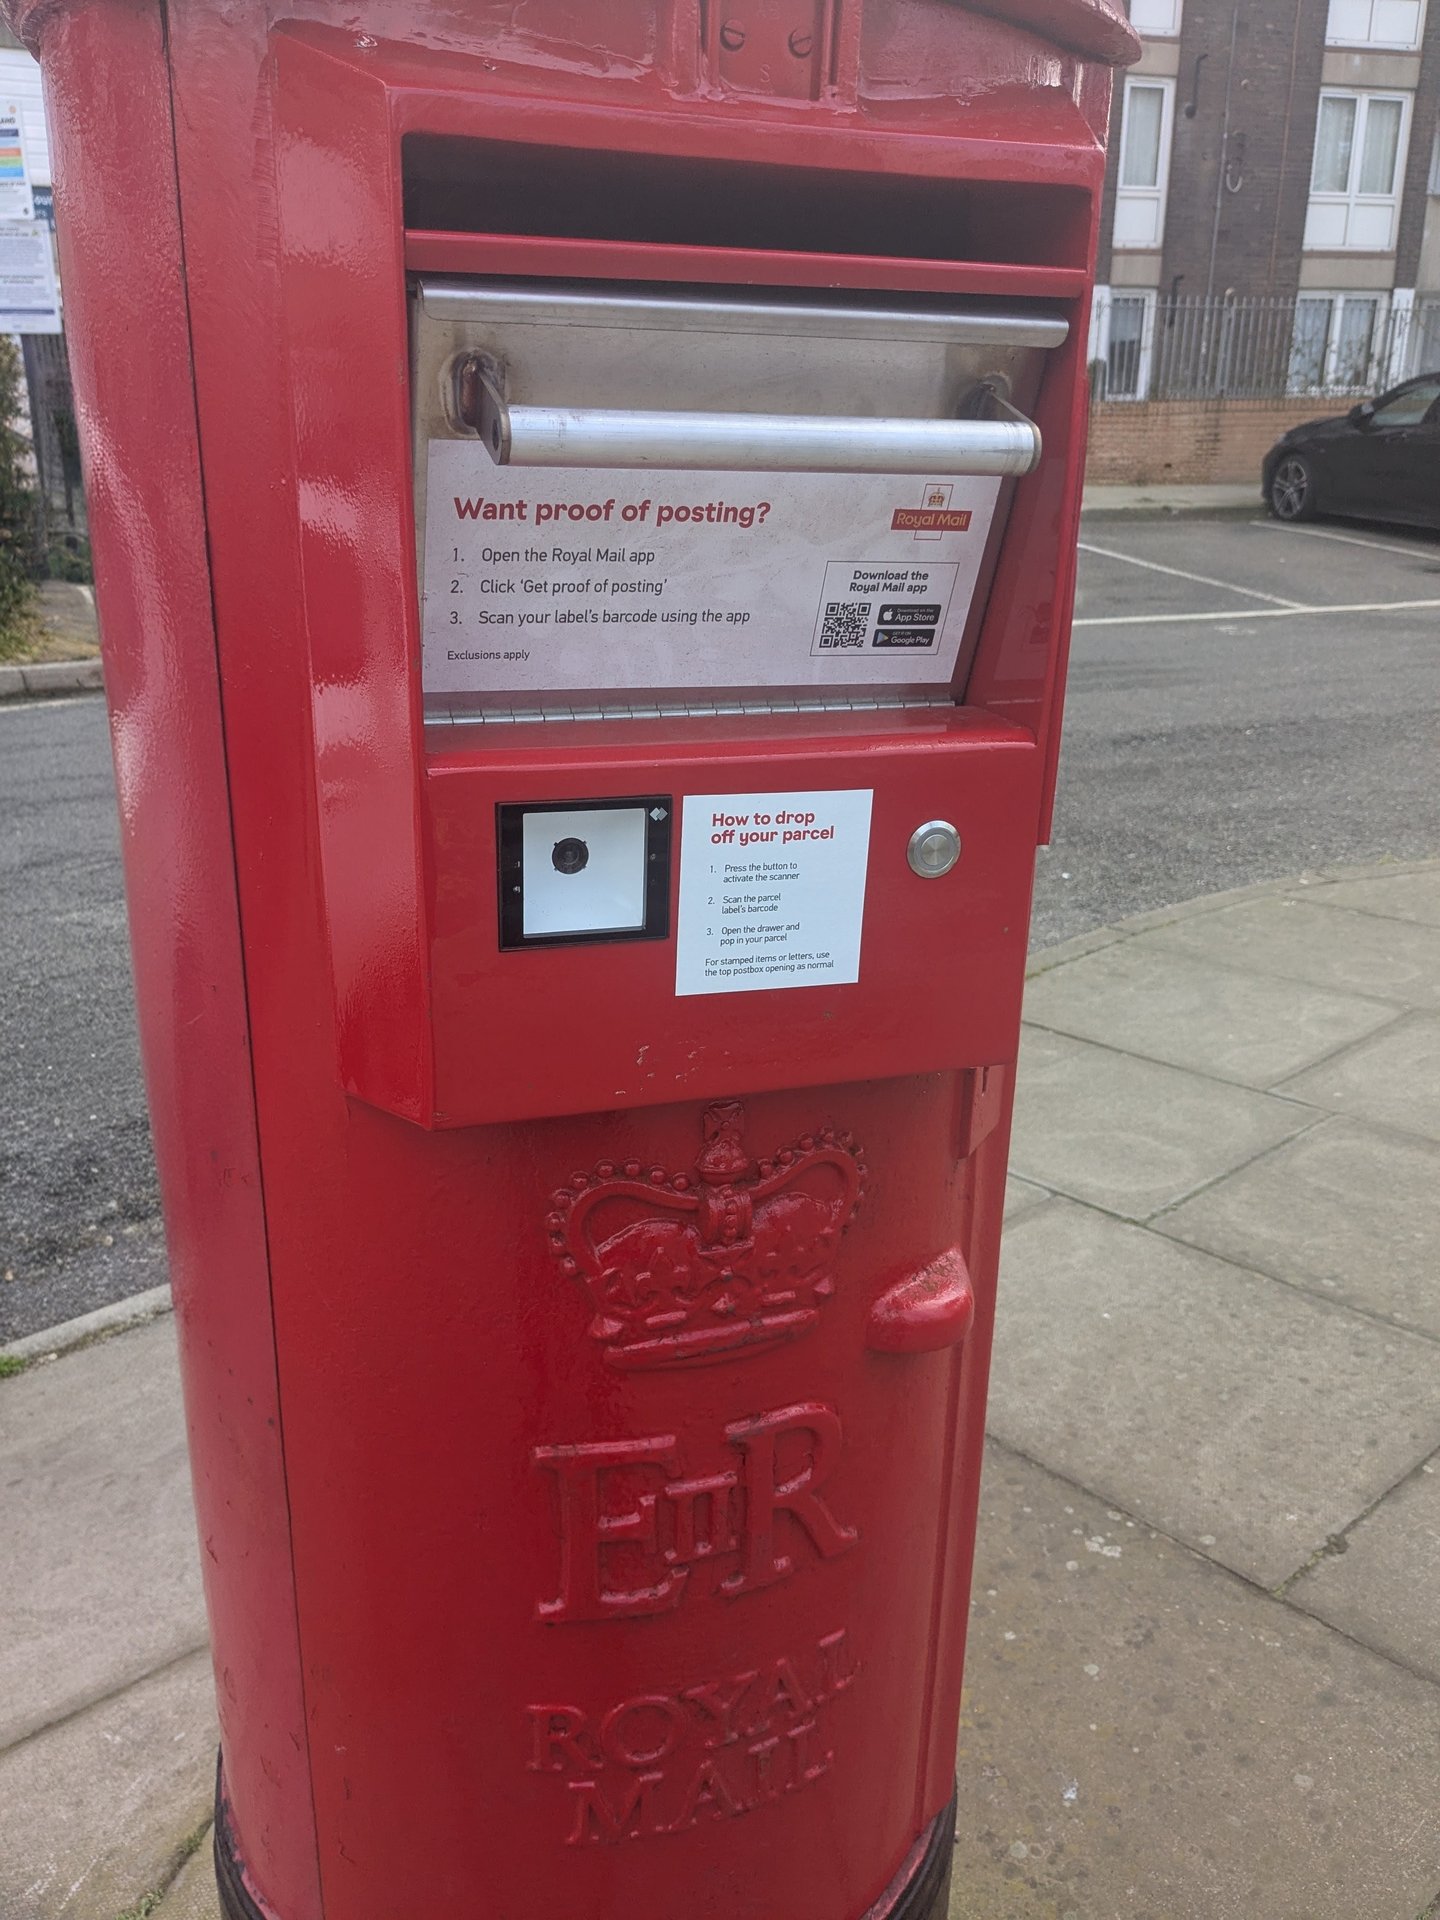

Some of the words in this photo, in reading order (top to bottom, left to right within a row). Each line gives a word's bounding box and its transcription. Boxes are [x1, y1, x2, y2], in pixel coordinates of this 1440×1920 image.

[453, 497, 528, 521] Want
[535, 499, 616, 526] proof
[621, 499, 652, 522] of
[656, 501, 771, 528] posting?
[896, 512, 935, 528] Royal
[936, 513, 968, 527] Mail
[452, 547, 465, 563] 1.
[481, 547, 520, 566] Open
[524, 547, 548, 563] the
[552, 547, 592, 566] Royal
[596, 547, 626, 563] Mail
[629, 550, 656, 566] app
[852, 570, 909, 581] Download
[911, 570, 929, 581] the
[450, 579, 464, 594] 2.
[480, 578, 516, 594] Click
[552, 578, 591, 597] proof
[594, 578, 609, 594] of
[849, 582, 880, 595] Royal
[881, 582, 905, 593] Mail
[907, 584, 928, 595] app
[449, 610, 463, 625] 3.
[478, 610, 514, 625] Scan
[518, 612, 551, 628] your
[602, 609, 658, 623] barcode
[661, 609, 698, 626] using
[701, 609, 723, 623] the
[726, 611, 751, 626] app
[895, 613, 912, 622] App
[913, 613, 935, 621] Store
[891, 636, 915, 645] Google
[916, 636, 930, 645] Play
[447, 650, 501, 661] Exclusions
[503, 649, 531, 662] apply
[712, 813, 749, 827] How
[753, 813, 771, 825] to
[775, 811, 815, 826] drop
[711, 829, 736, 844] off
[739, 829, 779, 846] your
[782, 826, 834, 844] parcel
[710, 865, 717, 873] 1.
[724, 864, 747, 872] Press
[749, 863, 761, 871] the
[763, 862, 788, 871] button
[790, 862, 798, 870] to
[723, 874, 754, 883] activate
[755, 873, 768, 882] the
[769, 873, 800, 881] scanner
[707, 896, 715, 905] 2.
[723, 895, 742, 904] Scan
[744, 894, 756, 903] the
[758, 893, 781, 903] parcel
[747, 903, 778, 913] barcode
[706, 928, 714, 936] 3.
[721, 927, 742, 936] Open
[743, 925, 756, 934] the
[757, 924, 784, 932] drawer
[786, 922, 800, 931] and
[720, 937, 735, 946] pop
[736, 936, 744, 944] in
[745, 936, 763, 945] your
[764, 933, 787, 944] parcel
[705, 958, 719, 966] For
[720, 955, 754, 966] stamped
[755, 954, 777, 963] items
[778, 954, 787, 962] or
[788, 952, 814, 961] letters,
[816, 951, 830, 959] use
[705, 968, 718, 976] the
[719, 967, 732, 977] top
[733, 965, 764, 976] postbox
[765, 963, 795, 973] opening
[796, 962, 806, 970] as
[807, 960, 834, 969] normal
[524, 1628, 863, 1773] ROYAL
[564, 1720, 835, 1846] MAIL
